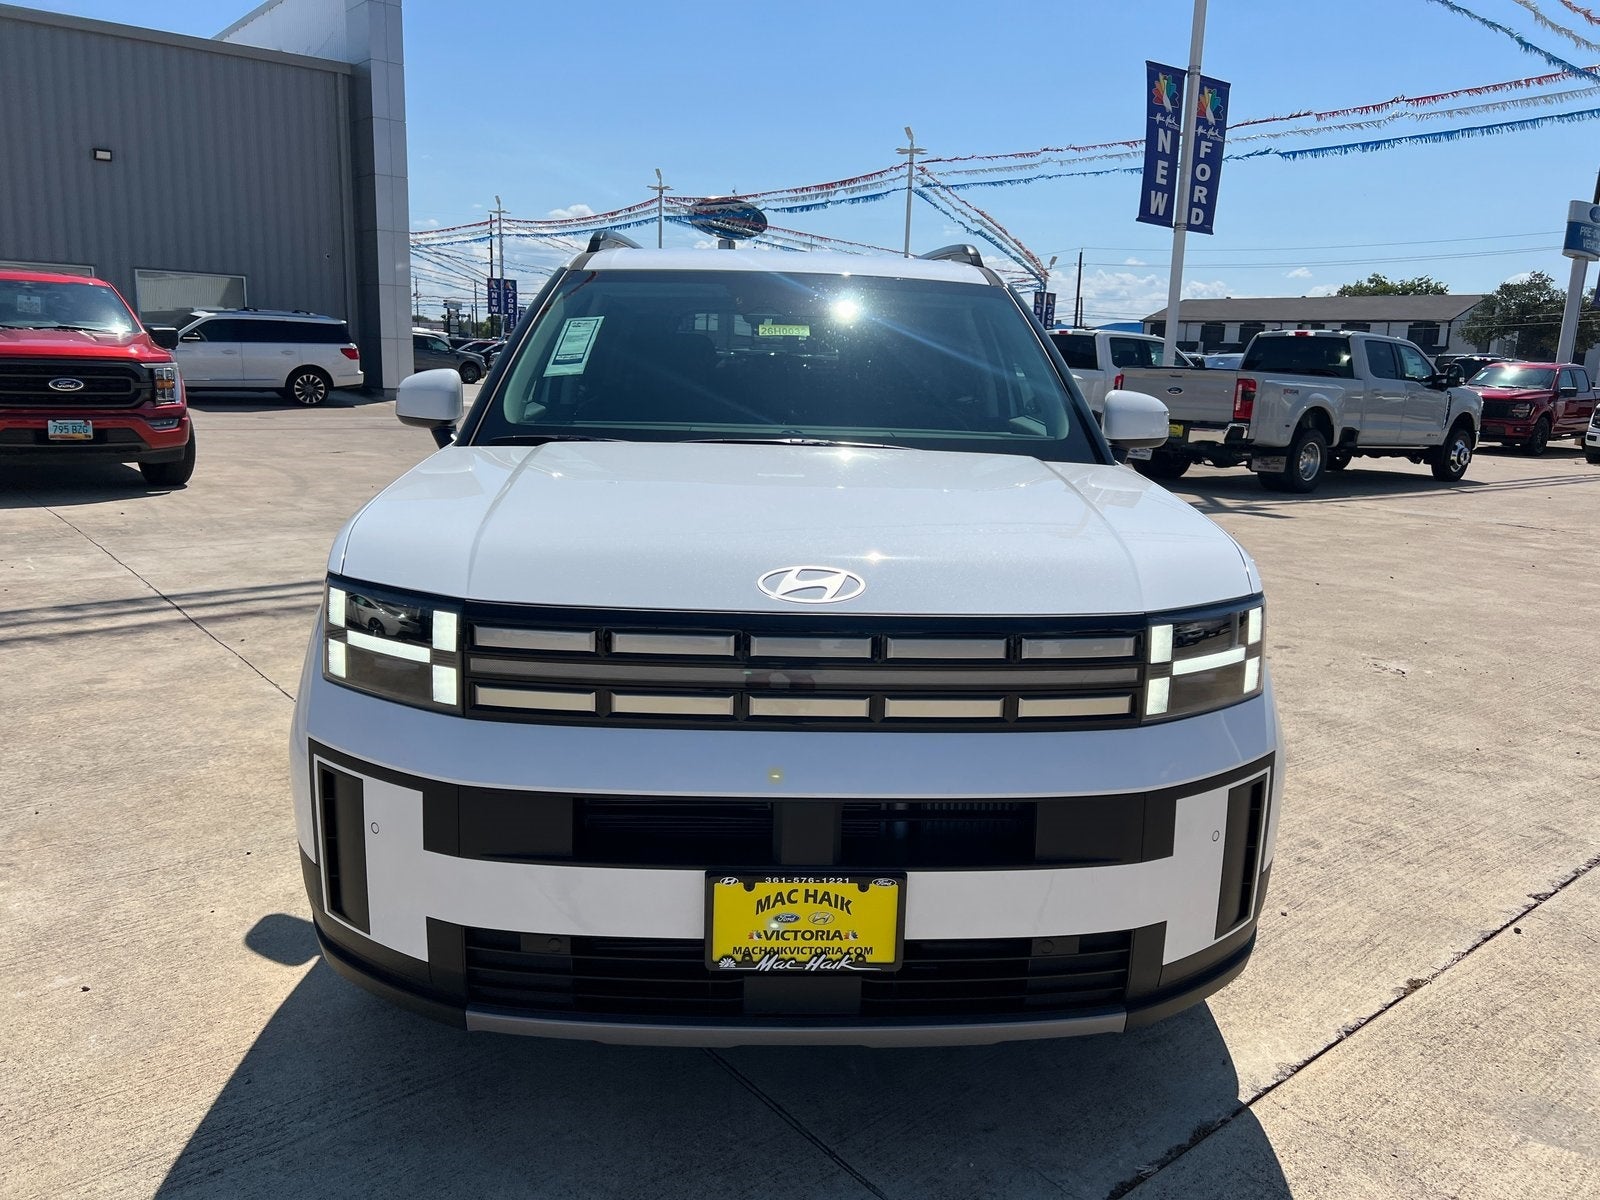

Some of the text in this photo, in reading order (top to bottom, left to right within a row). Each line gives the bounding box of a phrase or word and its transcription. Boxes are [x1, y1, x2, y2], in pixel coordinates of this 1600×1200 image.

[1150, 128, 1172, 216] NEW
[1191, 141, 1213, 225] FORD
[491, 292, 499, 313] NEW
[53, 425, 88, 434] 795 BZG
[764, 876, 850, 884] 361-576-1221
[755, 888, 853, 915] MAC HAIK
[763, 929, 844, 941] VICTORIA
[732, 946, 873, 956] MACHAIKVICTORIA.COM
[755, 953, 857, 971] Mac Haik
